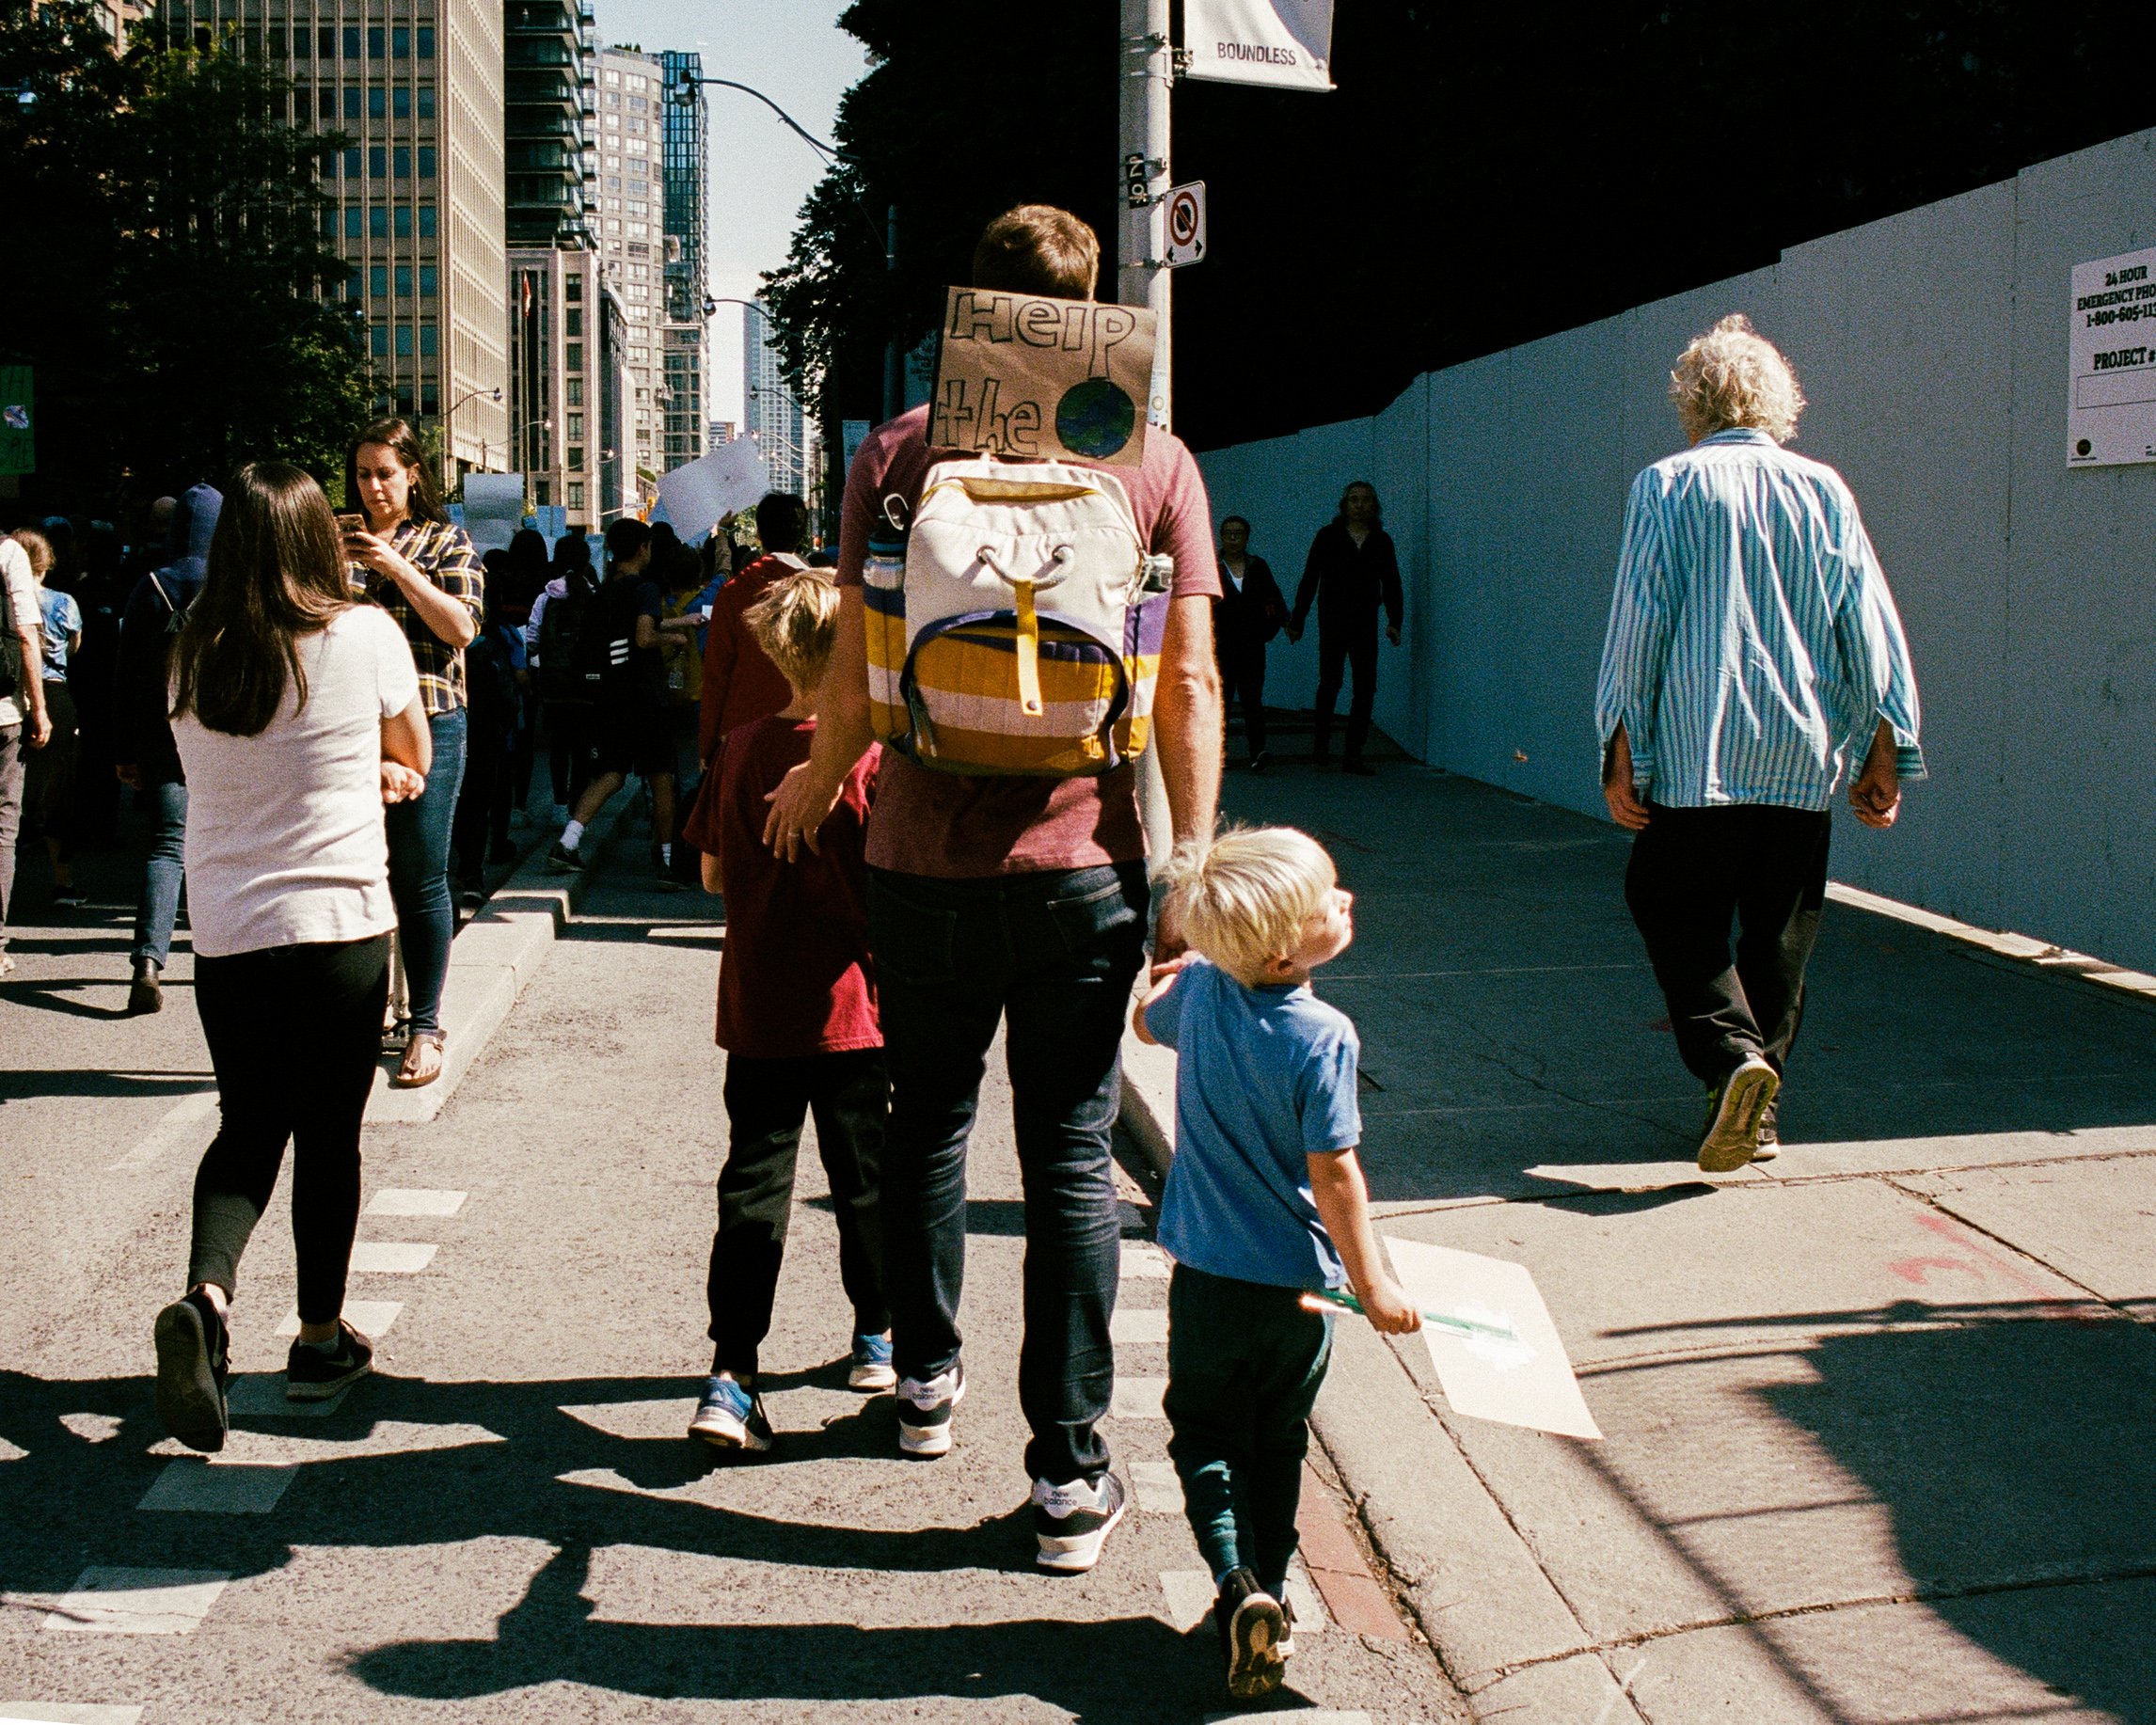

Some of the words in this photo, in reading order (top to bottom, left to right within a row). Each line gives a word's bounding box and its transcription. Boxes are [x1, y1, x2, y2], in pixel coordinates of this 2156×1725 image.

[1217, 41, 1297, 66] BOUNDLESS
[2104, 272, 2118, 287] 24
[2119, 265, 2148, 284] HOUR
[2077, 287, 2134, 311] EMERGENCY
[2093, 346, 2148, 371] PROJECT
[2148, 349, 2156, 363] #
[937, 377, 1041, 455] the
[1044, 1496, 1078, 1506] balance
[1052, 1490, 1070, 1498] new
